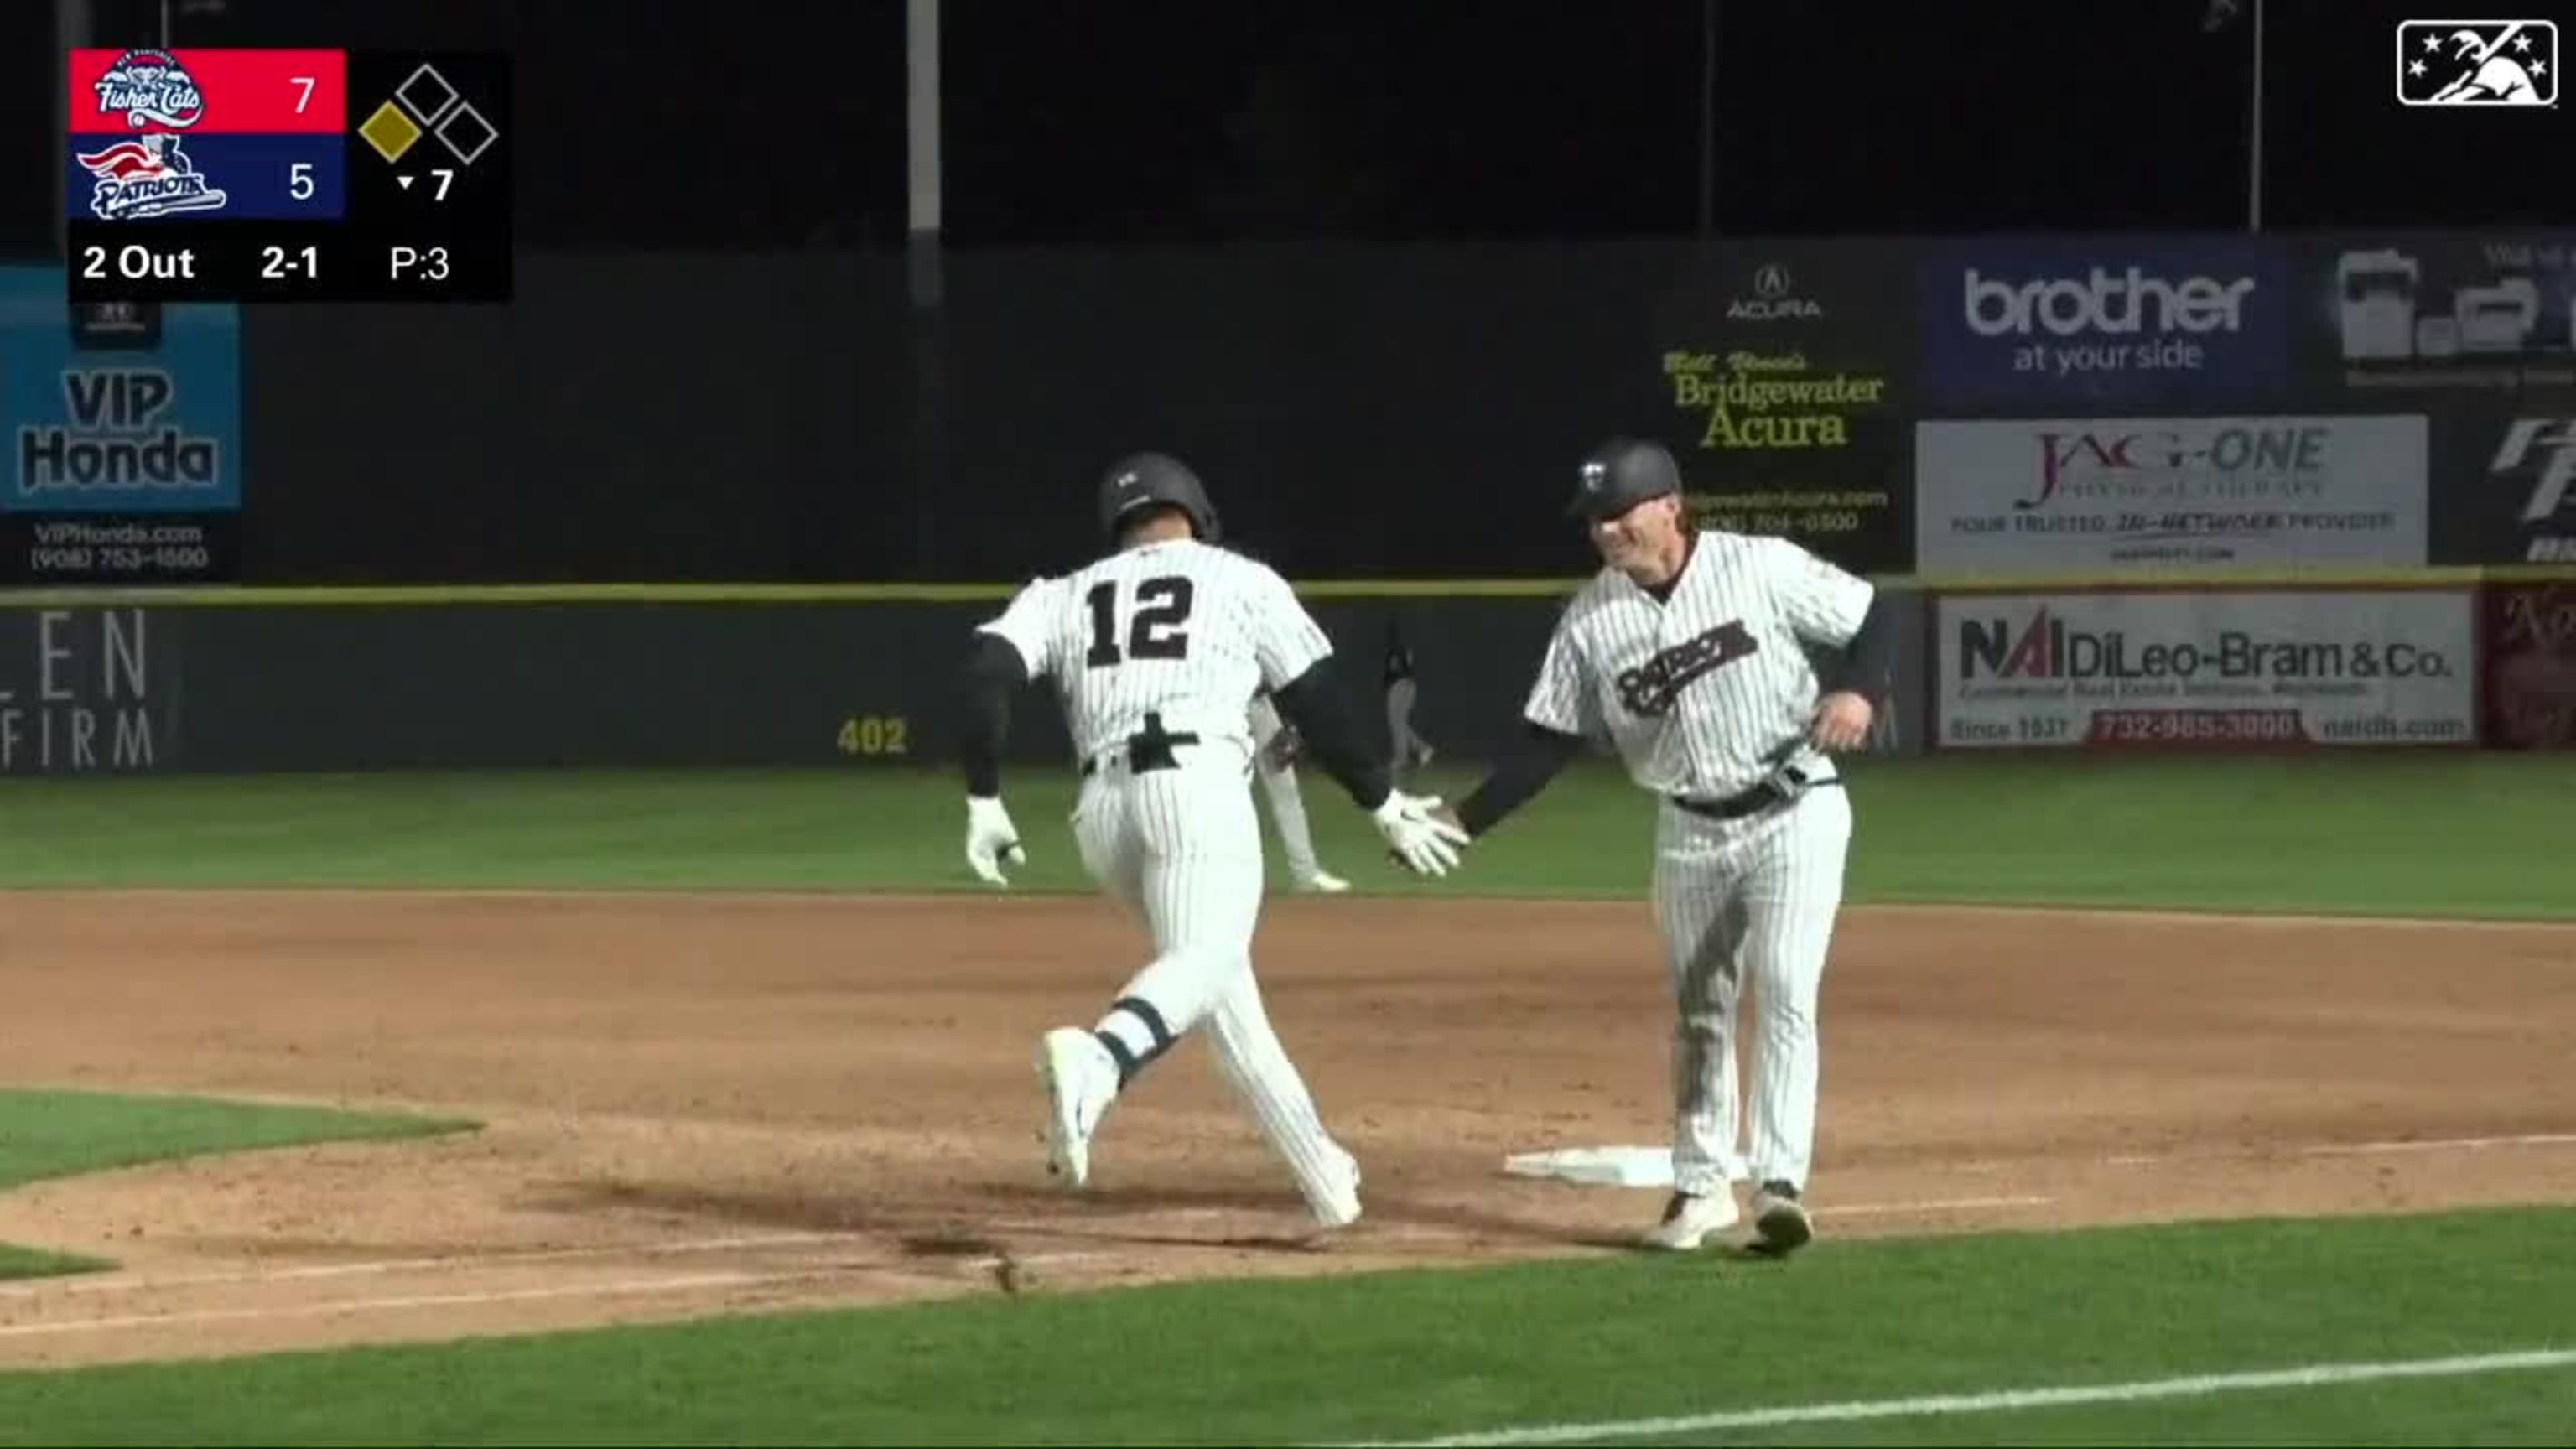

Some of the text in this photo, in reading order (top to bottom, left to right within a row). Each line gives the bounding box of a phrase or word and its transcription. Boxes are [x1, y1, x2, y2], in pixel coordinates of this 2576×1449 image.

[1725, 299, 1823, 319] ACURA
[1963, 266, 2256, 336] brother
[2012, 338, 2205, 378] at your side
[64, 371, 171, 424] VIP
[1675, 372, 1885, 412] Bridgewater
[1699, 402, 1849, 449] Acura
[19, 428, 216, 489] Honda
[33, 522, 205, 544] VIPHonda.com
[1086, 574, 1195, 668] 12
[1960, 605, 2453, 678] NAI DiLeo-Bram & Co.
[0, 708, 154, 769] FIRM
[837, 718, 906, 754] 402
[1950, 715, 2012, 740] Since
